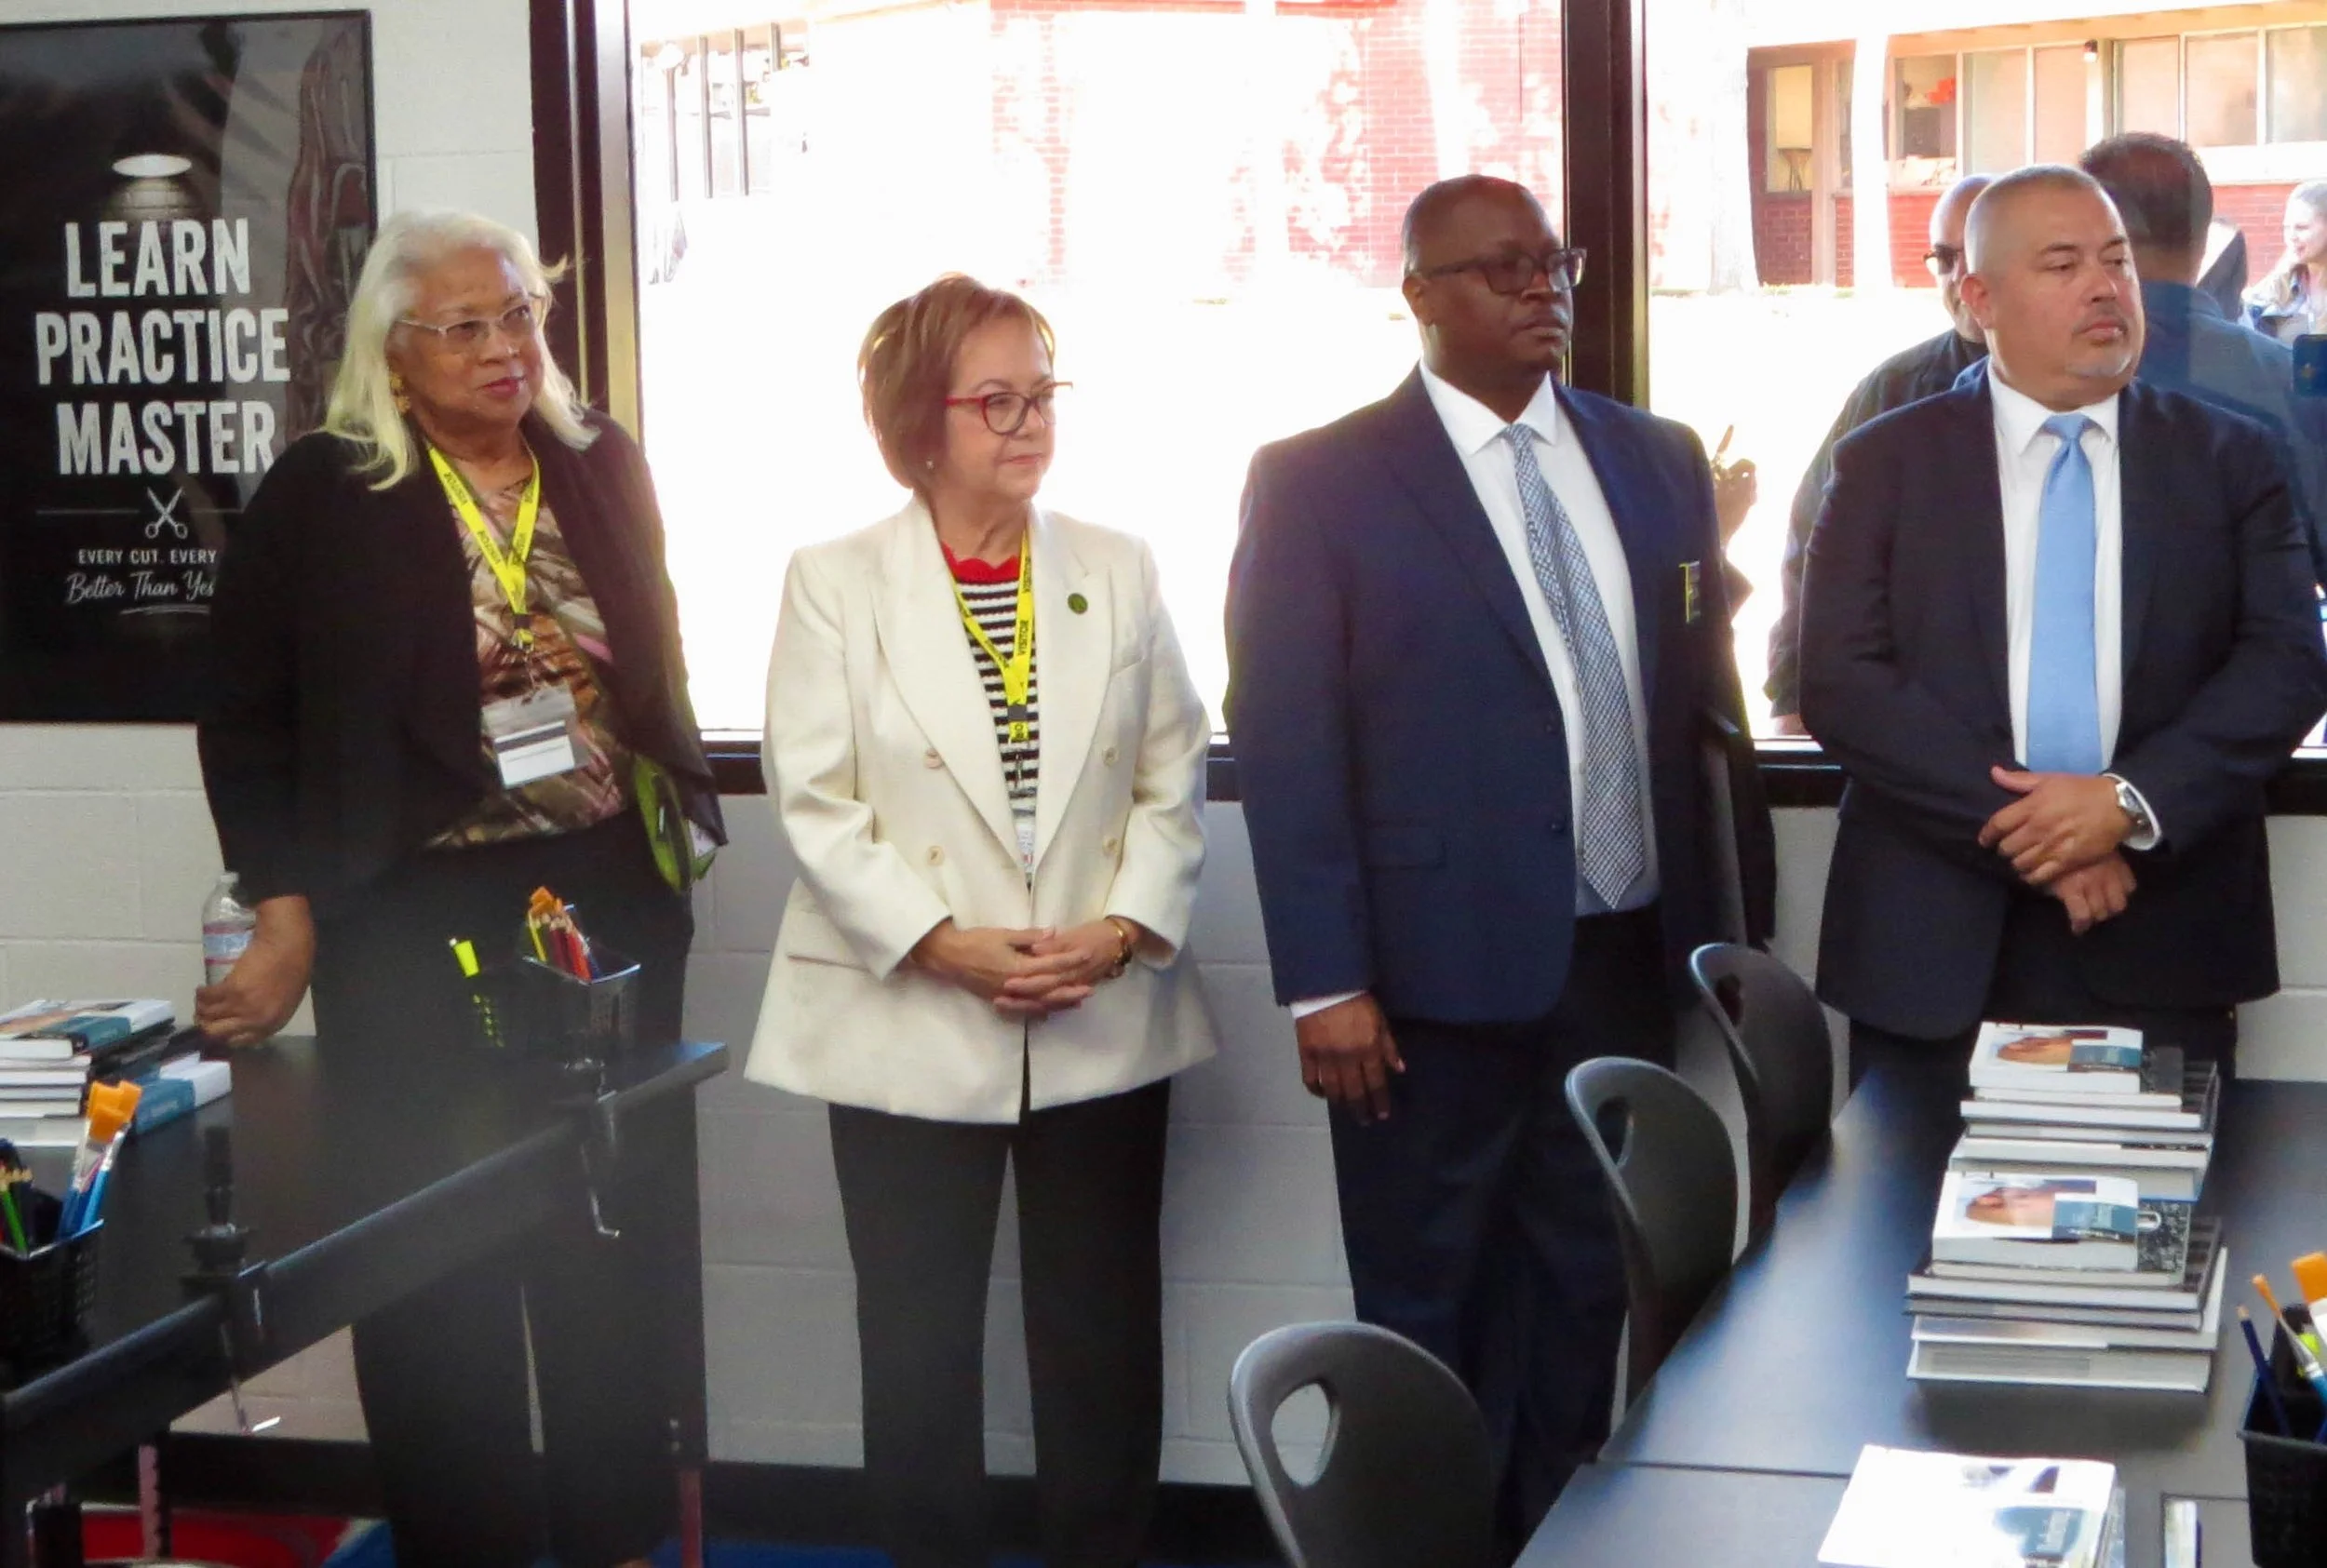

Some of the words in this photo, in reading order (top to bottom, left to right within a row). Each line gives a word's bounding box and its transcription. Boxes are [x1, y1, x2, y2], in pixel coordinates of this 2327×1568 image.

[64, 217, 252, 298] LEARN
[34, 308, 291, 385] PRACTICE
[56, 399, 276, 476] MASTER
[77, 548, 124, 565] EVERY
[169, 548, 217, 565] EVERY
[64, 571, 126, 605] Better
[128, 569, 179, 600] Than
[1017, 619, 1030, 656] VISITOR
